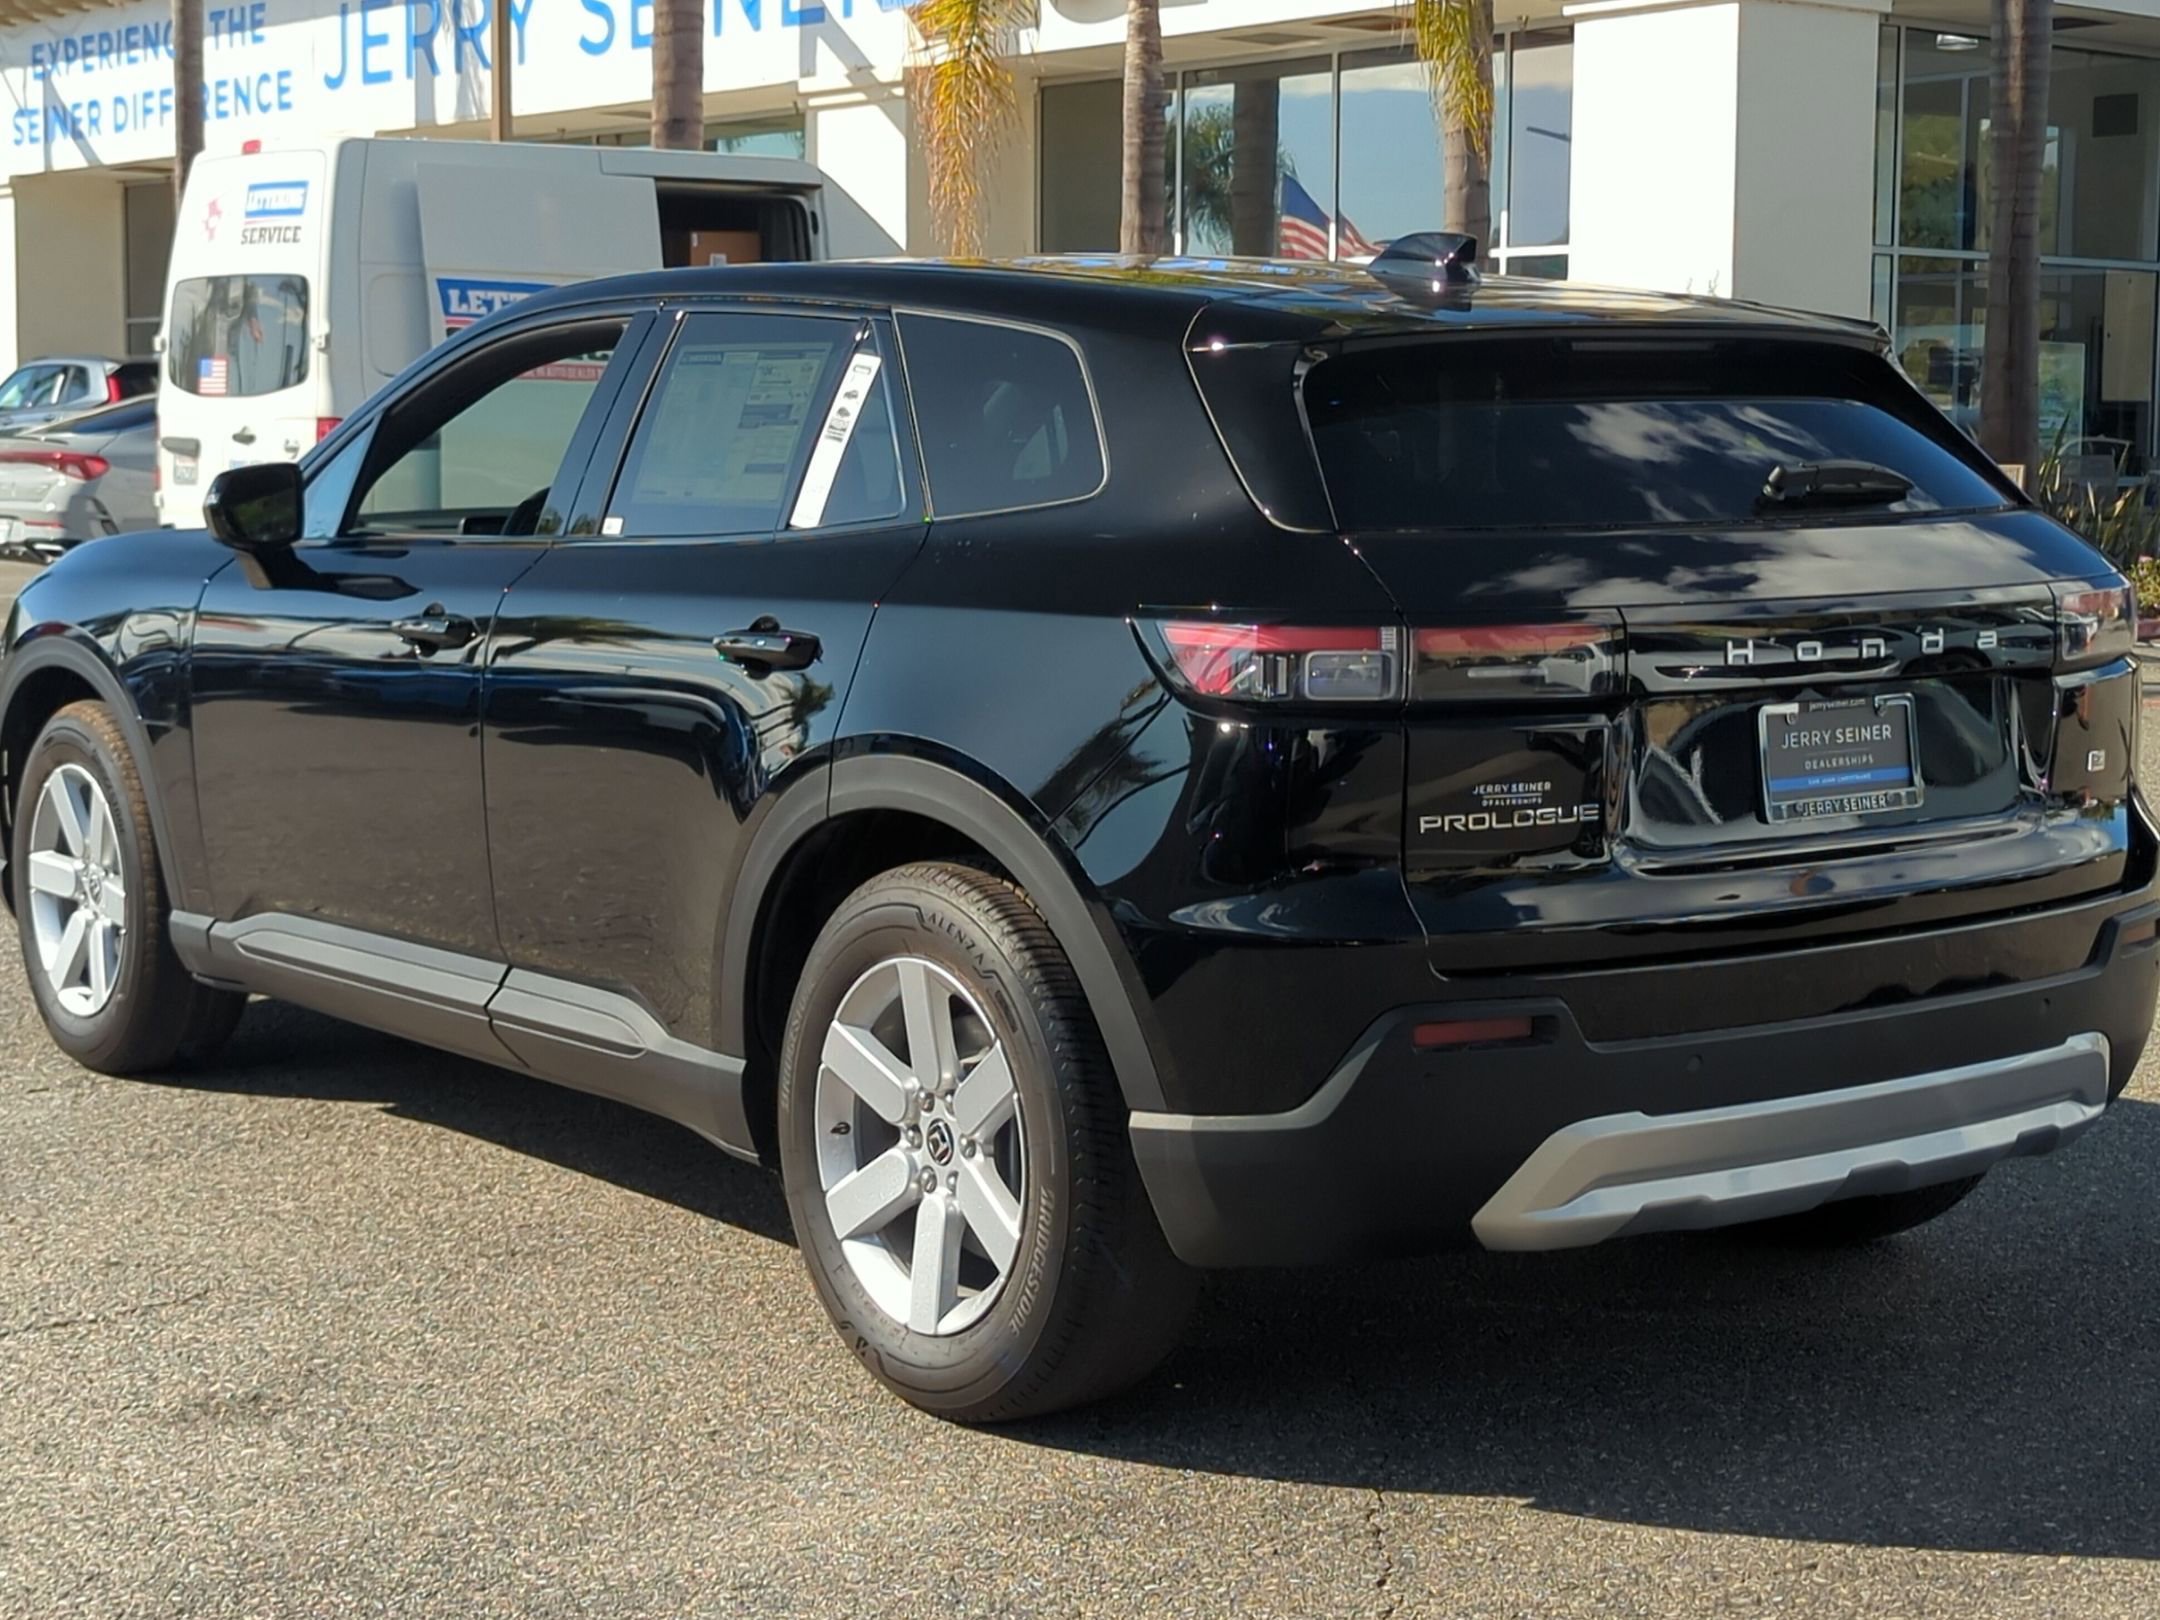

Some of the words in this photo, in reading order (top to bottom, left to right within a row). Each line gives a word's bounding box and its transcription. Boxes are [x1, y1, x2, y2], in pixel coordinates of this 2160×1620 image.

[31, 19, 177, 81] EXPERIENC
[209, 2, 266, 50] THE
[323, 0, 534, 90] JERRY
[12, 98, 102, 146] SEINER
[112, 69, 293, 134] DIFFRENCE
[241, 225, 302, 245] SERVICE
[1781, 729, 1831, 749] JERRY
[1835, 724, 1893, 744] SEINER
[1804, 753, 1874, 770] DEALERSHIPS
[1471, 783, 1510, 796] JERRY
[1511, 780, 1552, 793] SEINER
[1418, 803, 1600, 835] PROLOGUE
[1802, 801, 1842, 817] JERRY
[1844, 794, 1887, 812] SEINER
[927, 911, 985, 966] ALENZA
[1008, 1185, 1056, 1338] BRIDGESTONE
